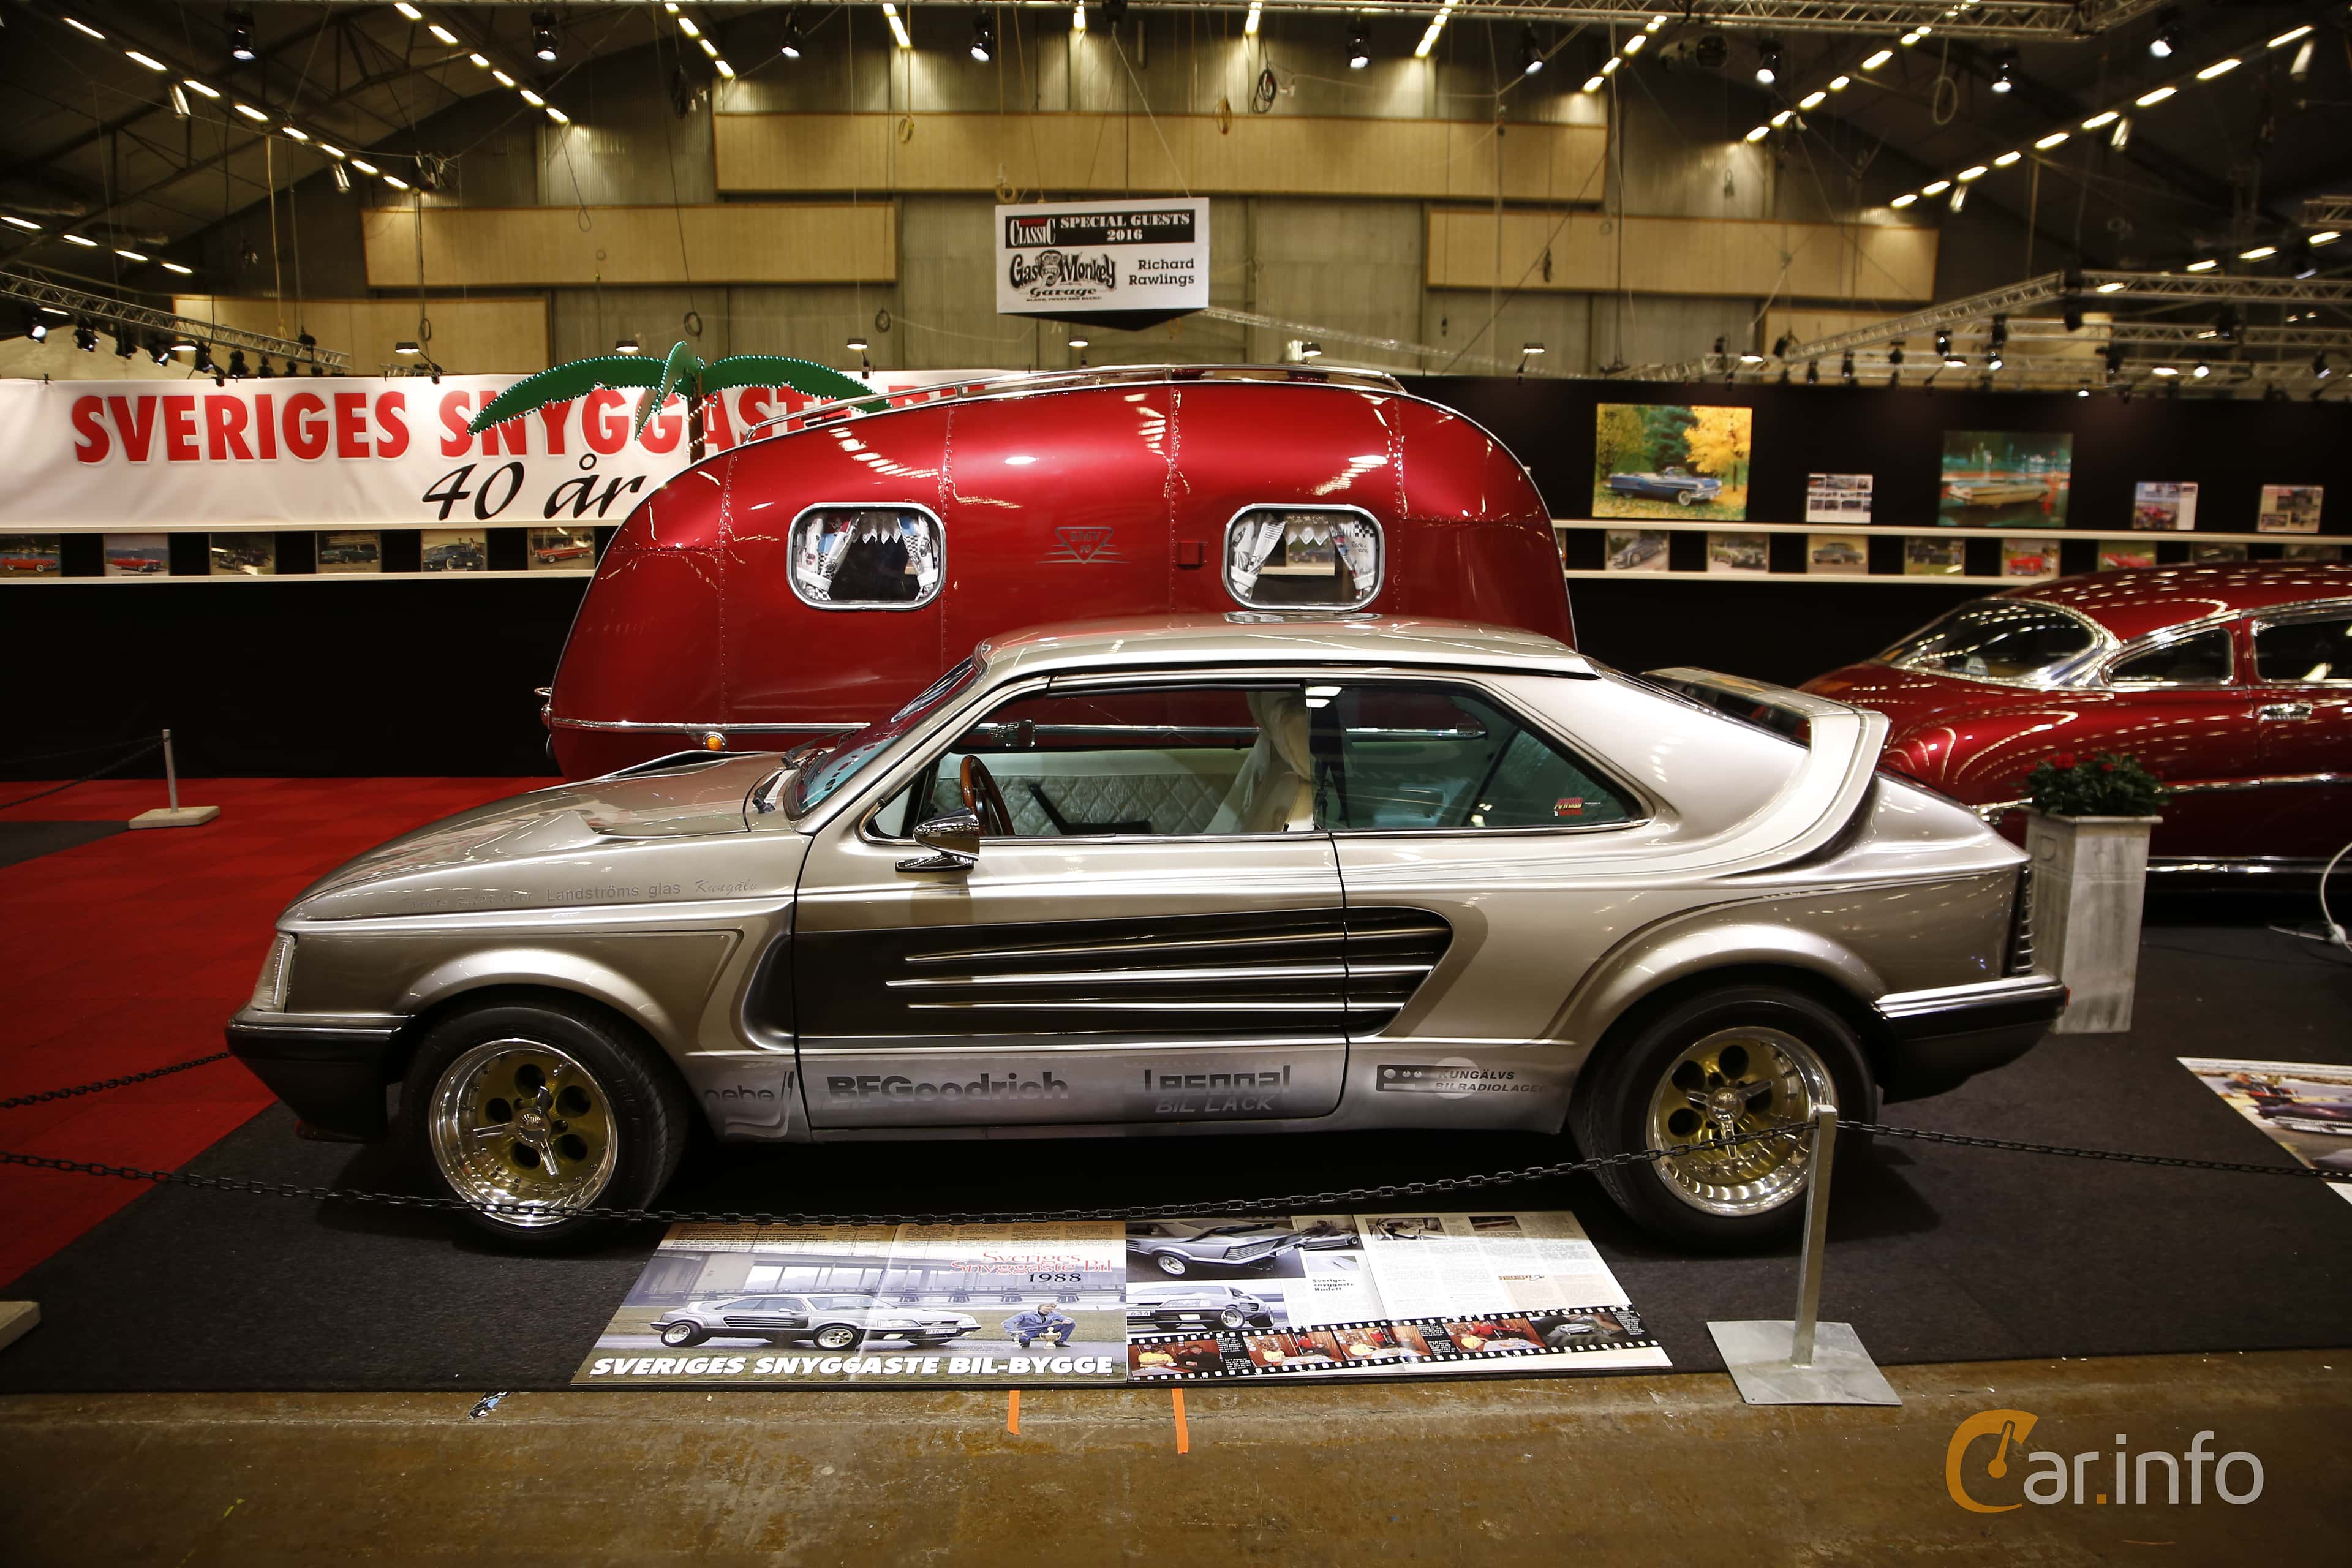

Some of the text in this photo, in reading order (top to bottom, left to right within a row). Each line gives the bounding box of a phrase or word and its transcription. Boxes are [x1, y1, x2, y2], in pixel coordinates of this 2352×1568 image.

[1060, 213, 1190, 229] SPECIAL GUESTS
[1107, 228, 1143, 241] 2016
[1011, 252, 1117, 290] Gas Monkey
[1138, 258, 1194, 270] Richard
[1129, 273, 1194, 287] Rawlings
[1030, 287, 1097, 298] Garage
[71, 391, 409, 463] SVERIGES
[422, 453, 647, 521] 40 år
[547, 884, 639, 902] Landströms
[648, 882, 682, 898] glas
[827, 1071, 1069, 1102] BFGoodrich
[1204, 1095, 1276, 1113] LACK
[981, 1251, 1080, 1265] Sveriges
[950, 1259, 1113, 1275] Snyggaste Bil
[1028, 1273, 1082, 1283] 1988
[590, 1356, 1114, 1376] SVERIGES SNYGGASTE BIL-BYGGE
